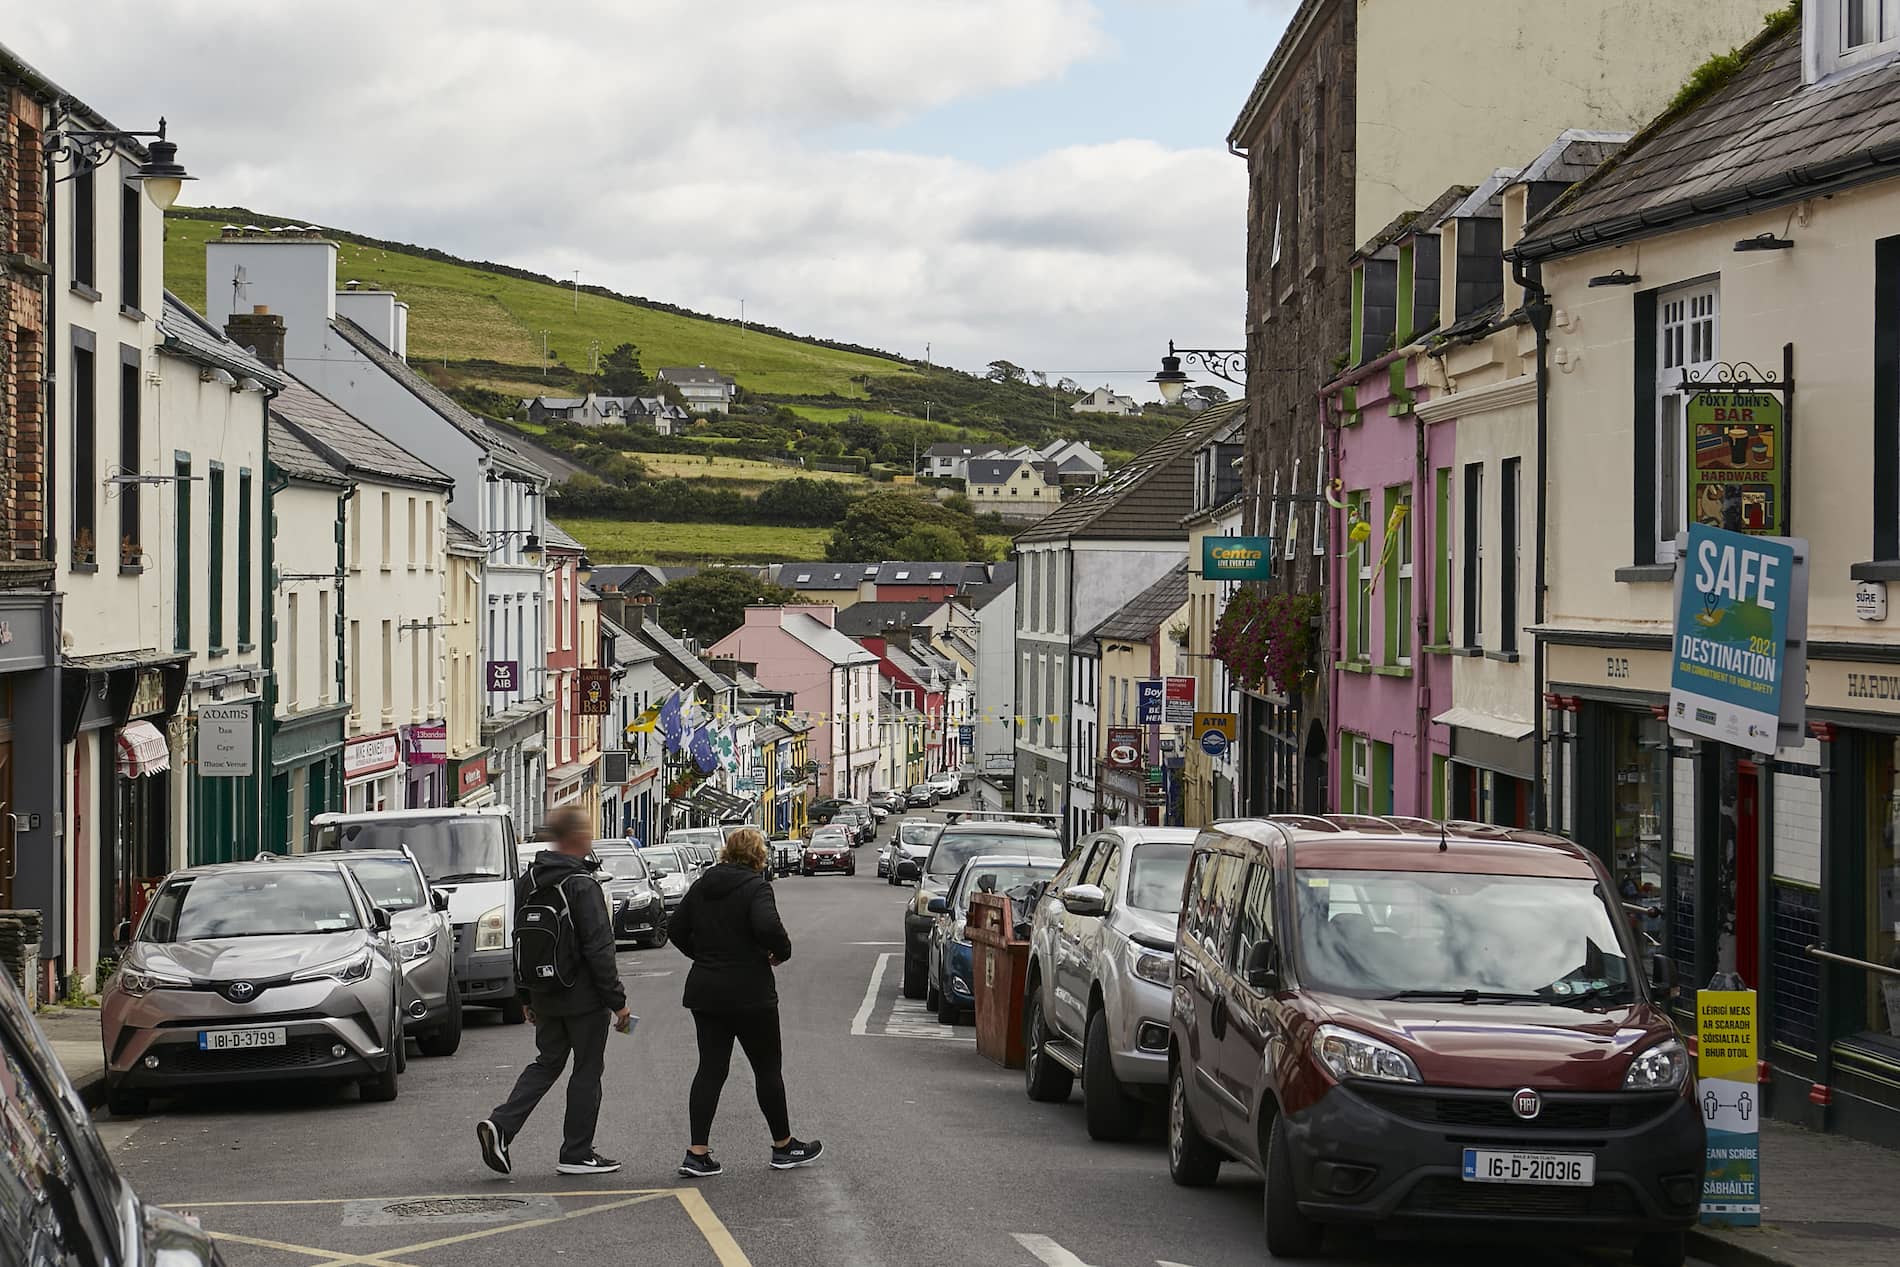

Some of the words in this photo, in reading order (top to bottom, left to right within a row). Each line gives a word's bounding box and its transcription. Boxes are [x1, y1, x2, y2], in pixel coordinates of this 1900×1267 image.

[1700, 395, 1728, 407] FOXY
[1732, 395, 1770, 407] JOHN'S
[1714, 408, 1753, 421] BAR
[1702, 471, 1768, 481] HARDWARE
[1211, 547, 1262, 559] Centra
[1695, 539, 1780, 610] SAFE
[1750, 635, 1777, 657] 2021
[1681, 635, 1776, 682] DESTINATION
[1607, 657, 1629, 678] BAR
[493, 679, 511, 688] AIB
[1692, 663, 1728, 683] COMMITMENT
[1729, 675, 1737, 684] TO
[1737, 677, 1752, 689] YOUR
[1752, 681, 1774, 695] SAFETY
[1144, 687, 1163, 698] Boy
[583, 700, 607, 713] B&B
[203, 709, 249, 719] ADAMS
[1203, 718, 1227, 727] ATM
[1729, 1006, 1751, 1016] MEAS
[1703, 1020, 1713, 1029] AR
[1715, 1020, 1750, 1030] SCARADH
[214, 1031, 275, 1048] 181-D-3799
[1741, 1034, 1751, 1044] LE
[1705, 1048, 1726, 1057] BHUR
[1519, 1097, 1536, 1111] FIAT
[1706, 1148, 1728, 1159] EANN
[1703, 1180, 1755, 1195] SÁBHÁILTE
